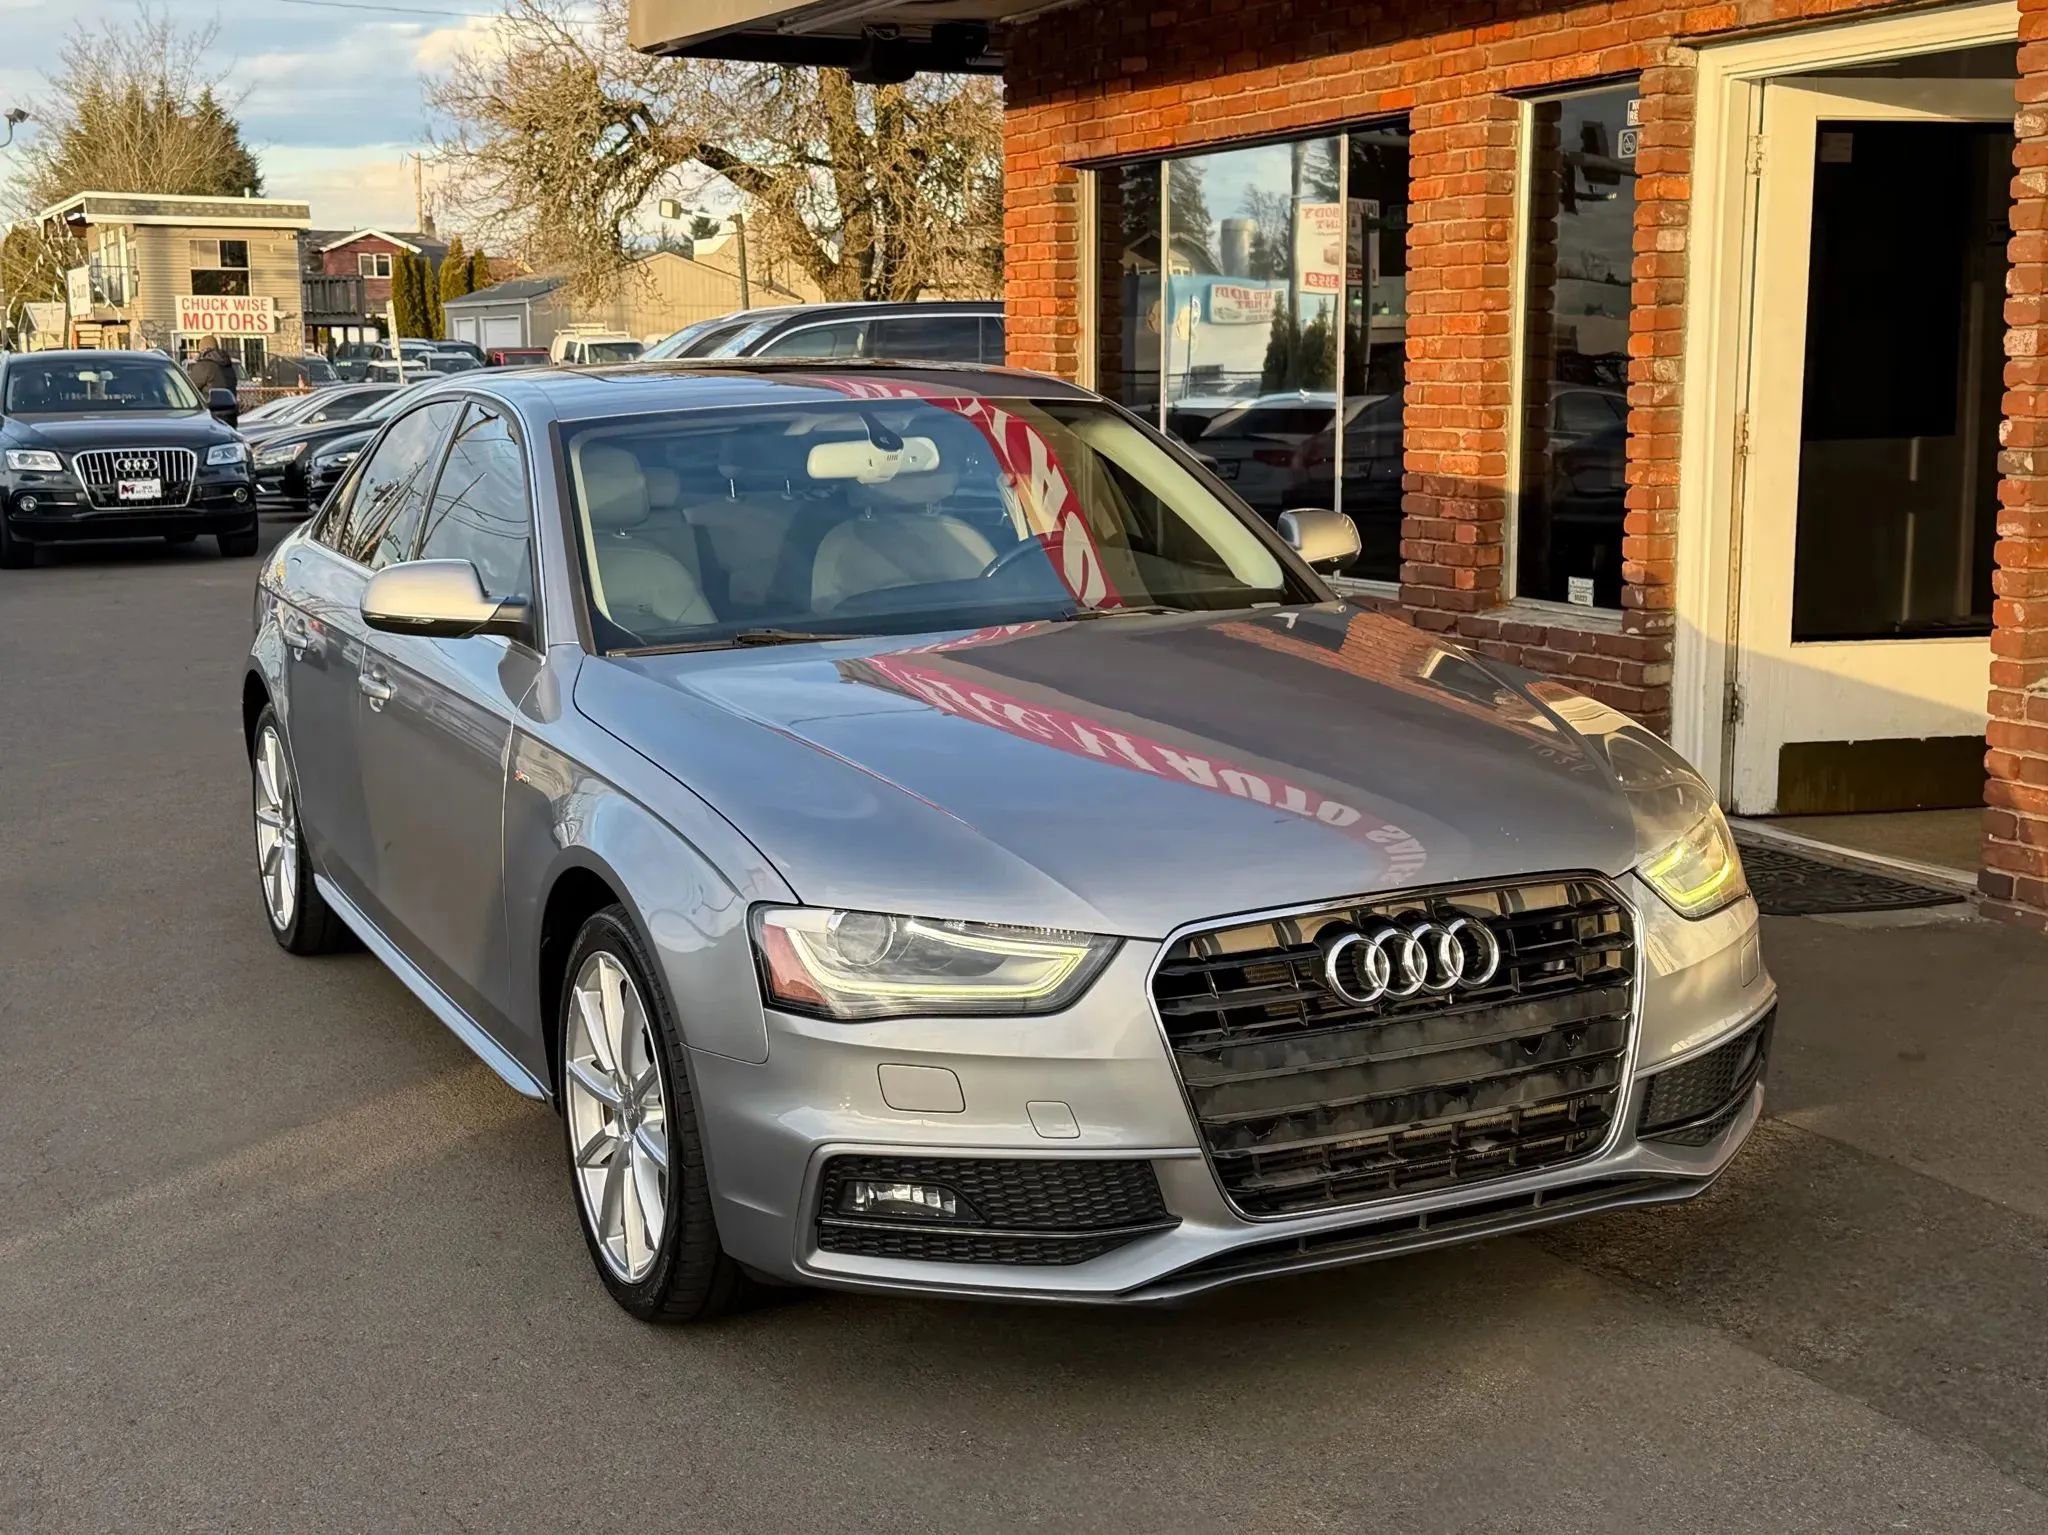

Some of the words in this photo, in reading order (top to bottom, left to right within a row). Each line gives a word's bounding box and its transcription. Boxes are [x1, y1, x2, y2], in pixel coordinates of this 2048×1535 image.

[181, 297, 229, 311] CHUCK
[233, 298, 268, 311] WISE
[183, 312, 268, 331] MOTORS
